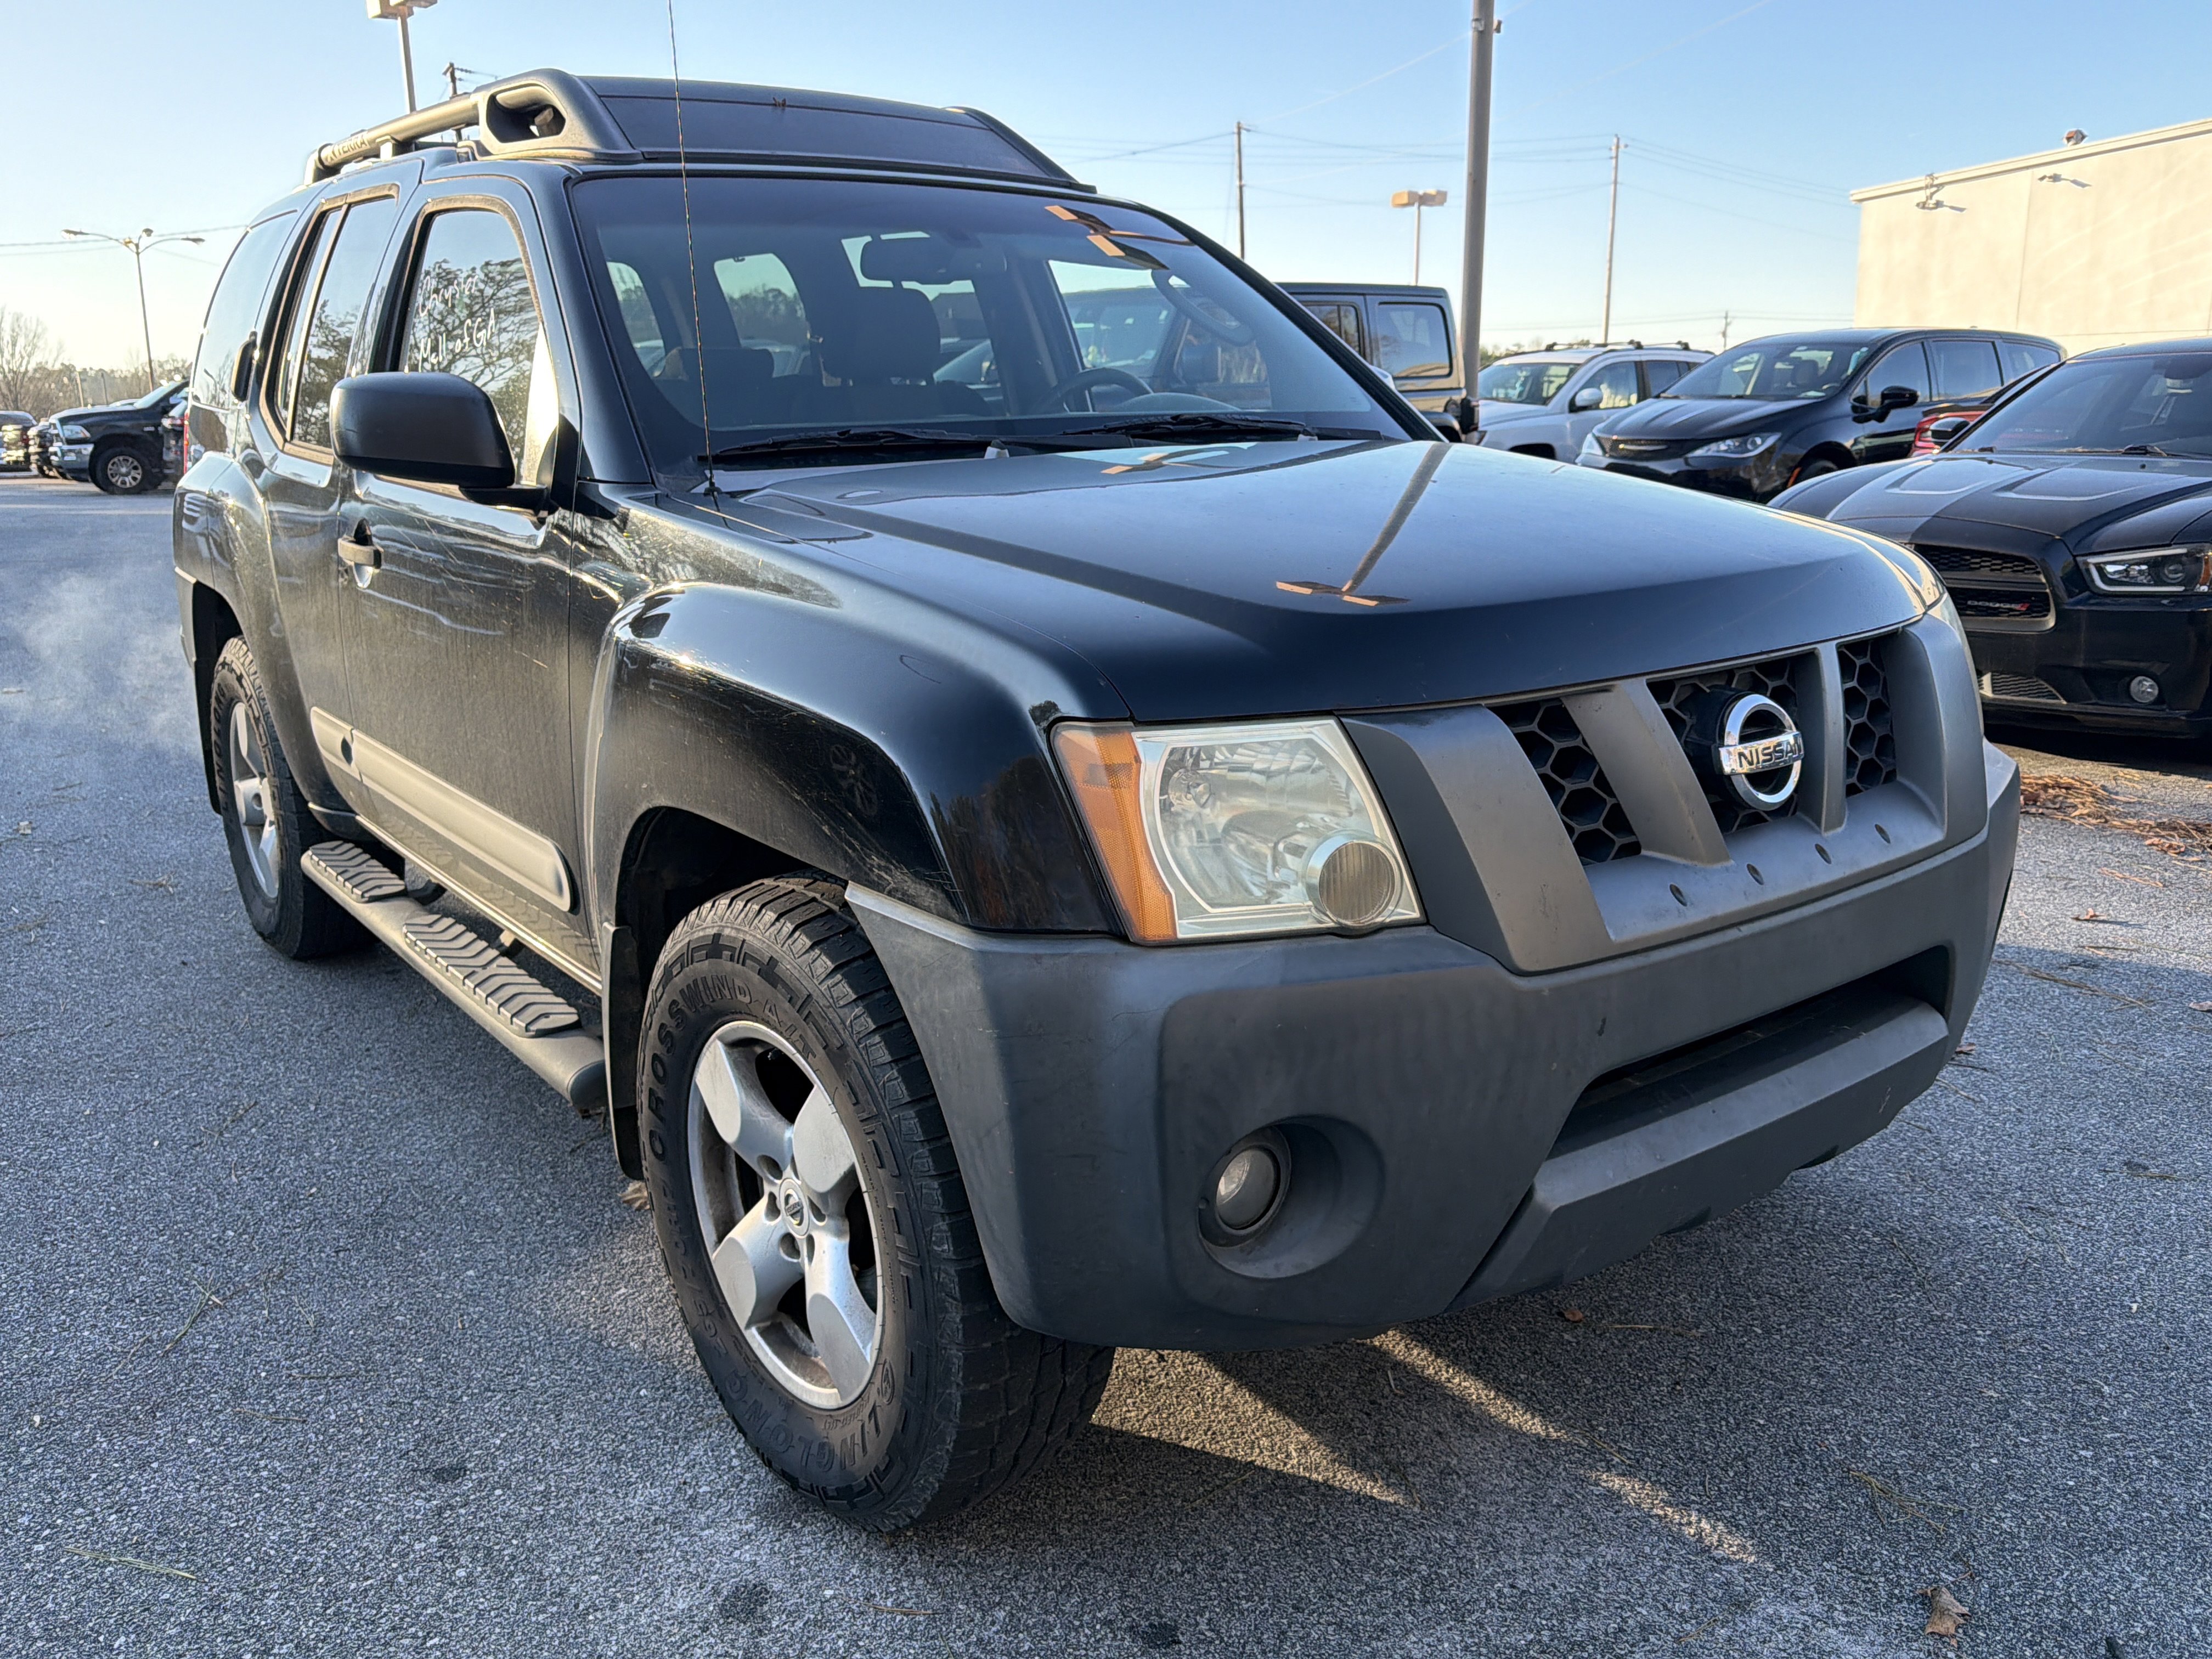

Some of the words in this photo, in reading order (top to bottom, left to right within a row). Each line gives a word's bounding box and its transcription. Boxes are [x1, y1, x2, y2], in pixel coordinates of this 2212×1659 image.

[419, 275, 478, 317] Chrysler
[455, 318, 472, 353] of
[473, 308, 495, 348] GA
[1737, 735, 1803, 769] NISSAN
[648, 974, 753, 1162] CROSSWIND
[725, 1370, 882, 1472] LINGLONG
